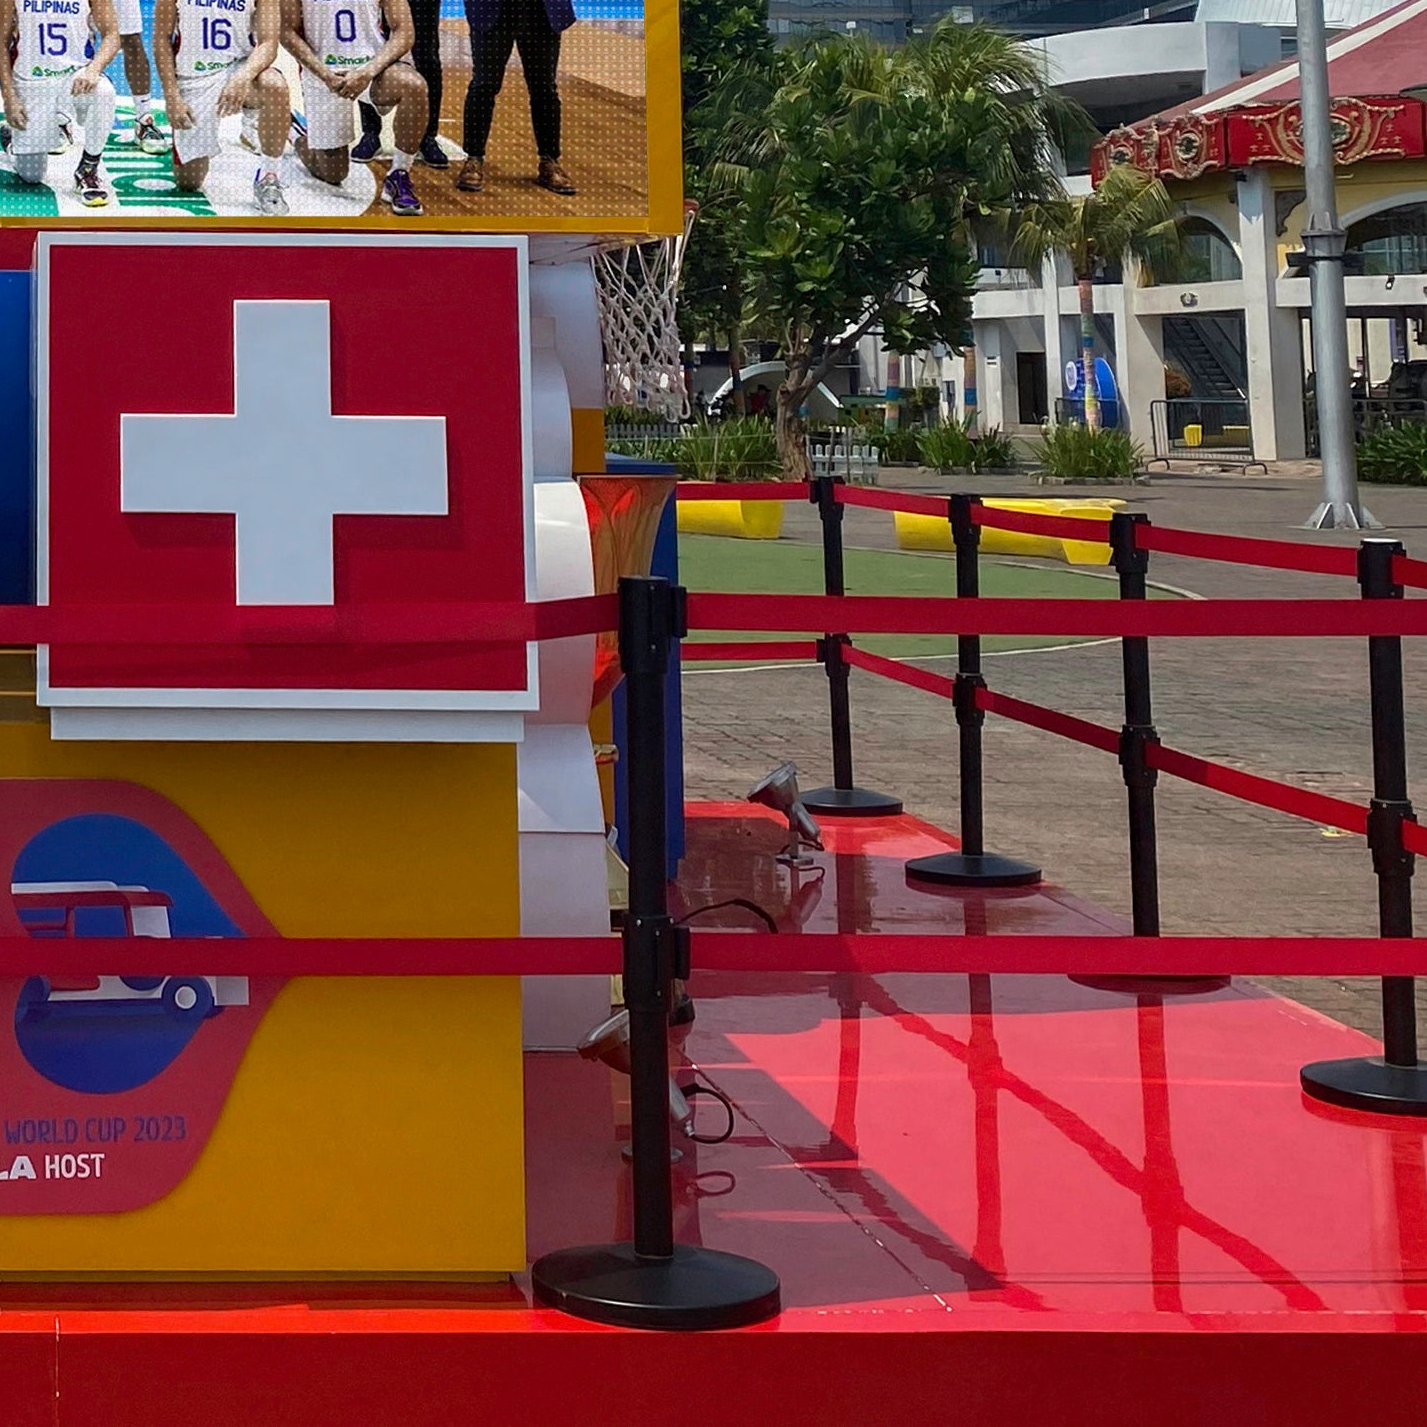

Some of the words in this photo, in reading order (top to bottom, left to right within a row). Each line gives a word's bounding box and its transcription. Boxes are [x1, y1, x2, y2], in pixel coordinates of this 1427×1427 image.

[23, 0, 80, 15] PILIPINAS
[38, 23, 67, 56] 15
[202, 17, 231, 50] 16
[334, 9, 356, 42] 0
[4, 1118, 81, 1145] WORLD
[84, 1117, 127, 1144] CUP
[134, 1115, 187, 1142] 2023
[44, 1153, 105, 1179] HOST
